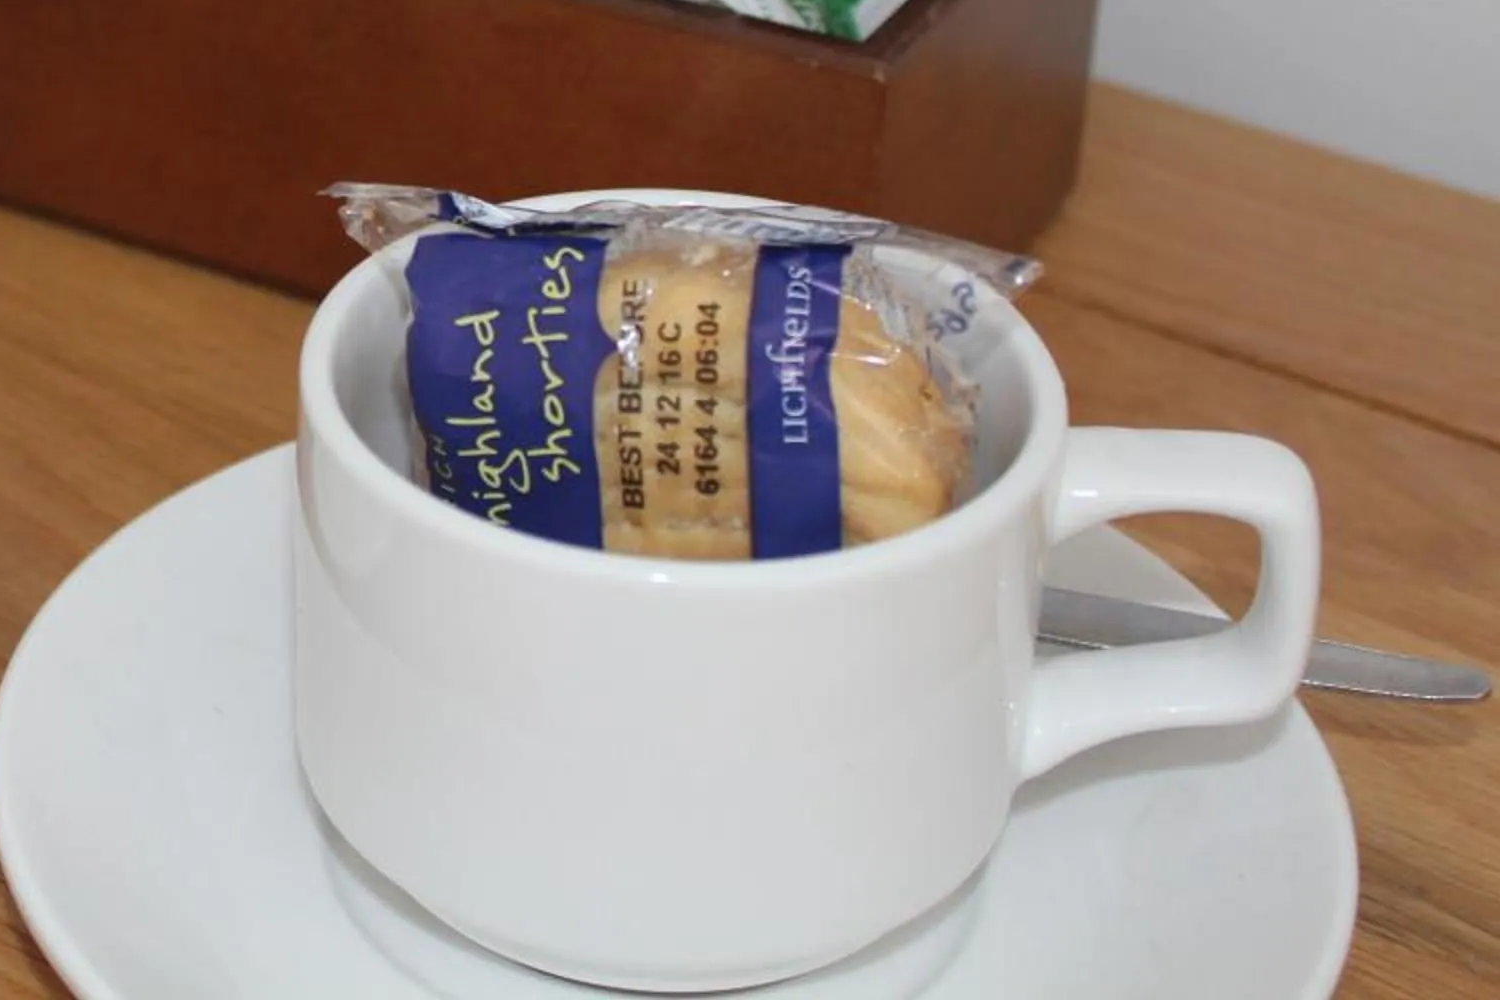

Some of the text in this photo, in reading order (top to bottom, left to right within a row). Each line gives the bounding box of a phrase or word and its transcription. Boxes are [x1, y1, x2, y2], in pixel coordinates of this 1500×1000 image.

[522, 246, 584, 483] shorties
[656, 322, 681, 476] 24 12 16 C
[694, 302, 720, 497] 6164 4 06:04
[617, 424, 645, 510] BEST
